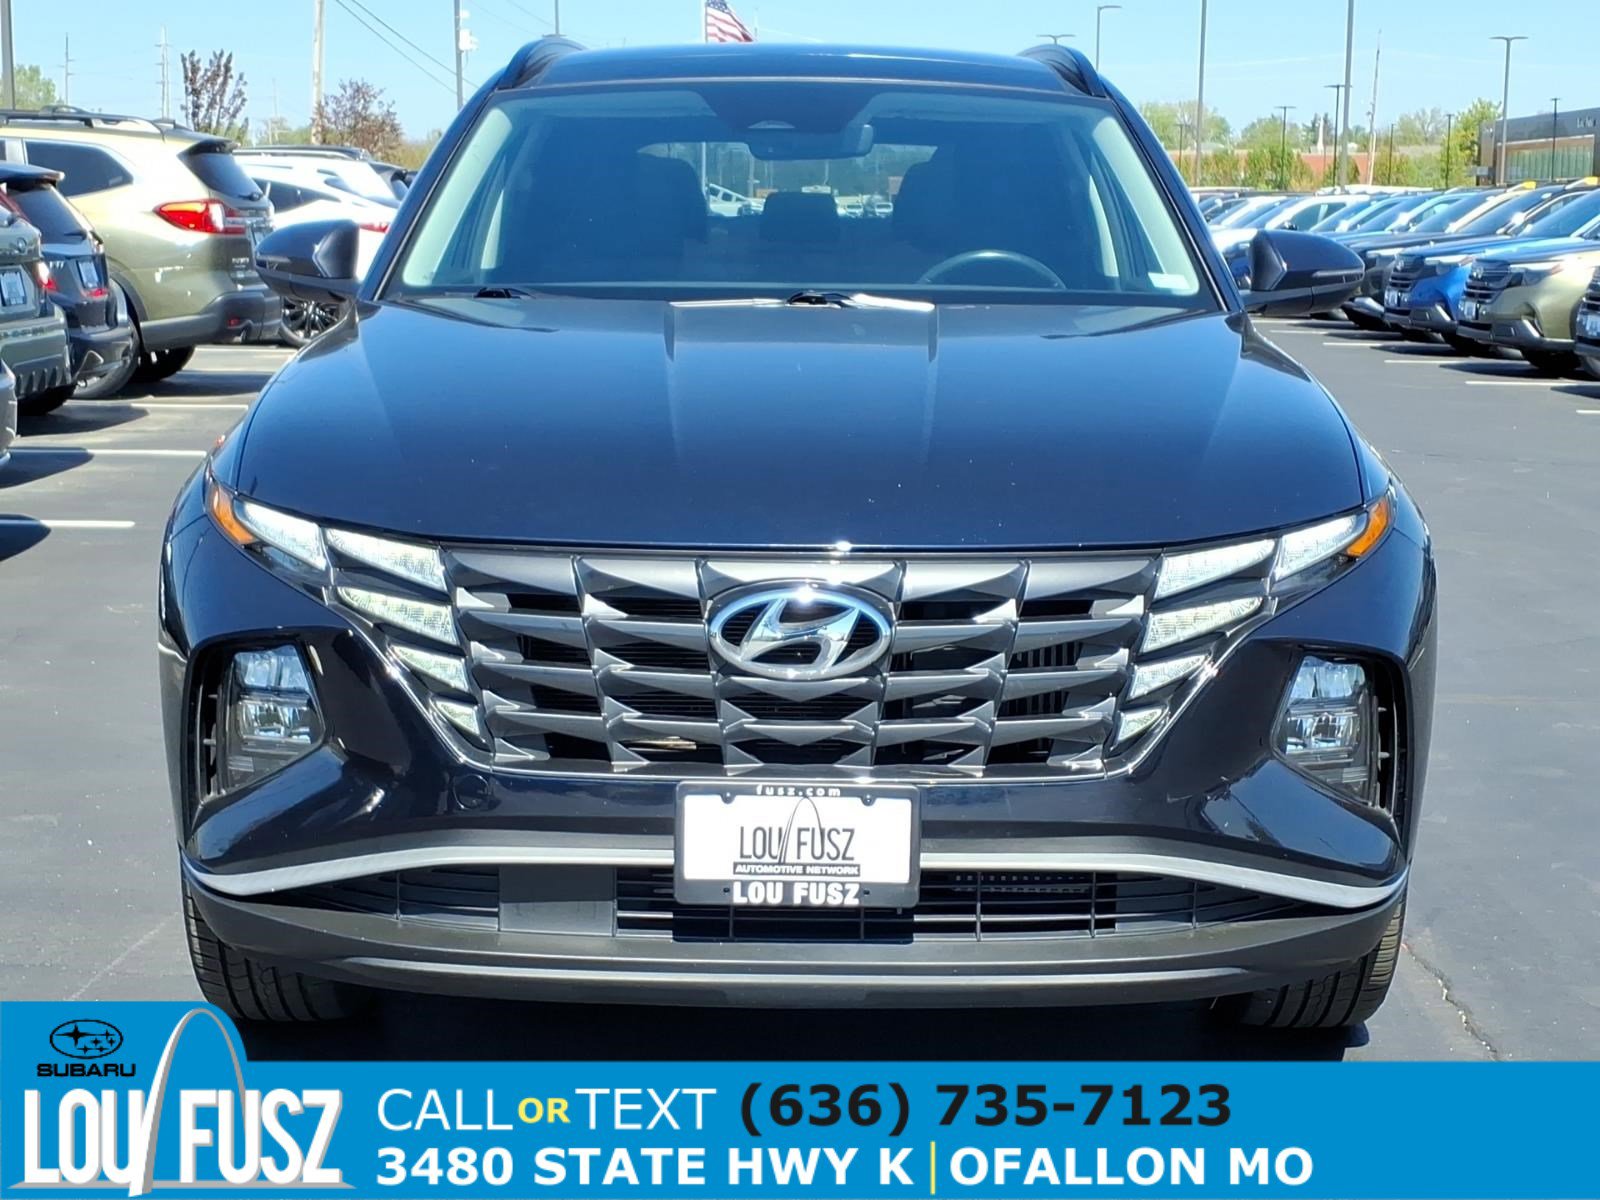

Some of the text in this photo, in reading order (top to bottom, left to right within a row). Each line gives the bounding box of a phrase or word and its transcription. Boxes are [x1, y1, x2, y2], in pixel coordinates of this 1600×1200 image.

[756, 785, 841, 797] fusz.com
[740, 826, 855, 861] LOU FUSZ
[735, 864, 860, 876] AUTOMOTIVE NETWORK
[733, 881, 861, 905] LOU FUSZ
